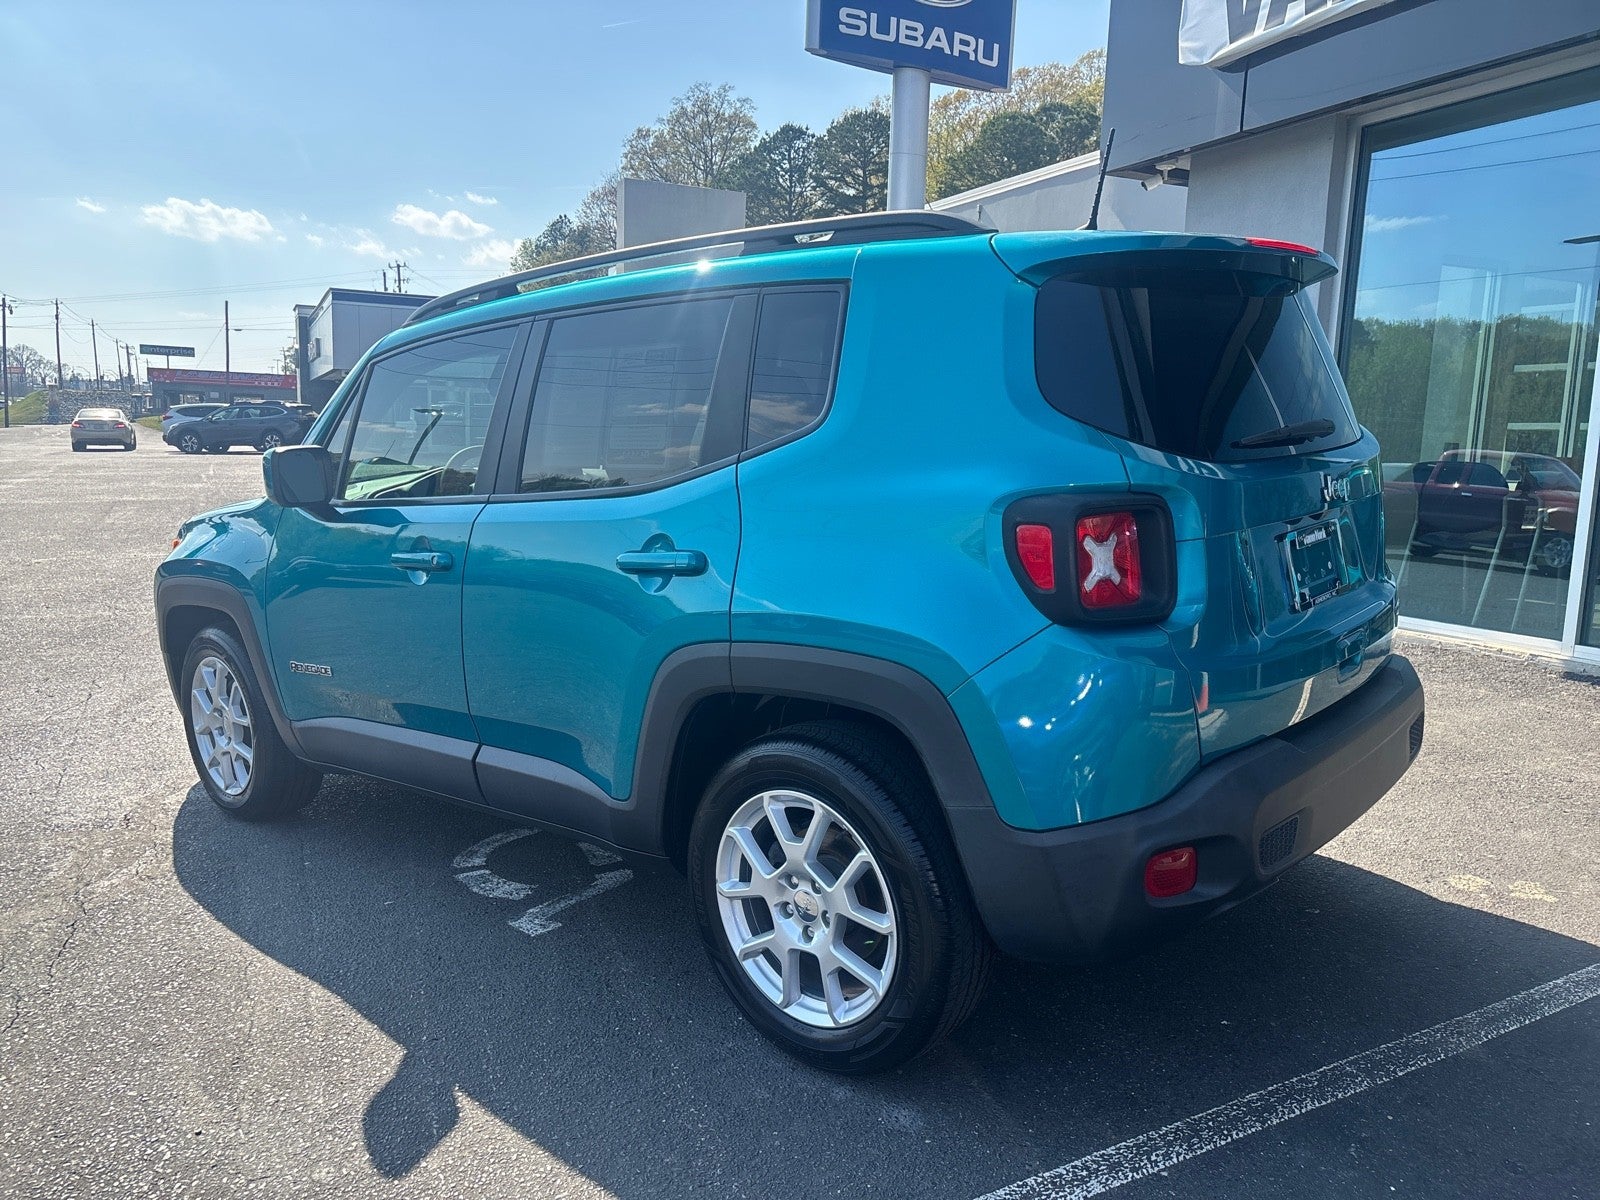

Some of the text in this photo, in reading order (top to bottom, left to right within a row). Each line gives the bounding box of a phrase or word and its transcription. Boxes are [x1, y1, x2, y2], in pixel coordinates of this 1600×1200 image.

[838, 6, 1000, 68] SUBARU
[1323, 475, 1350, 501] Jeep
[289, 660, 332, 677] RENEGADE
